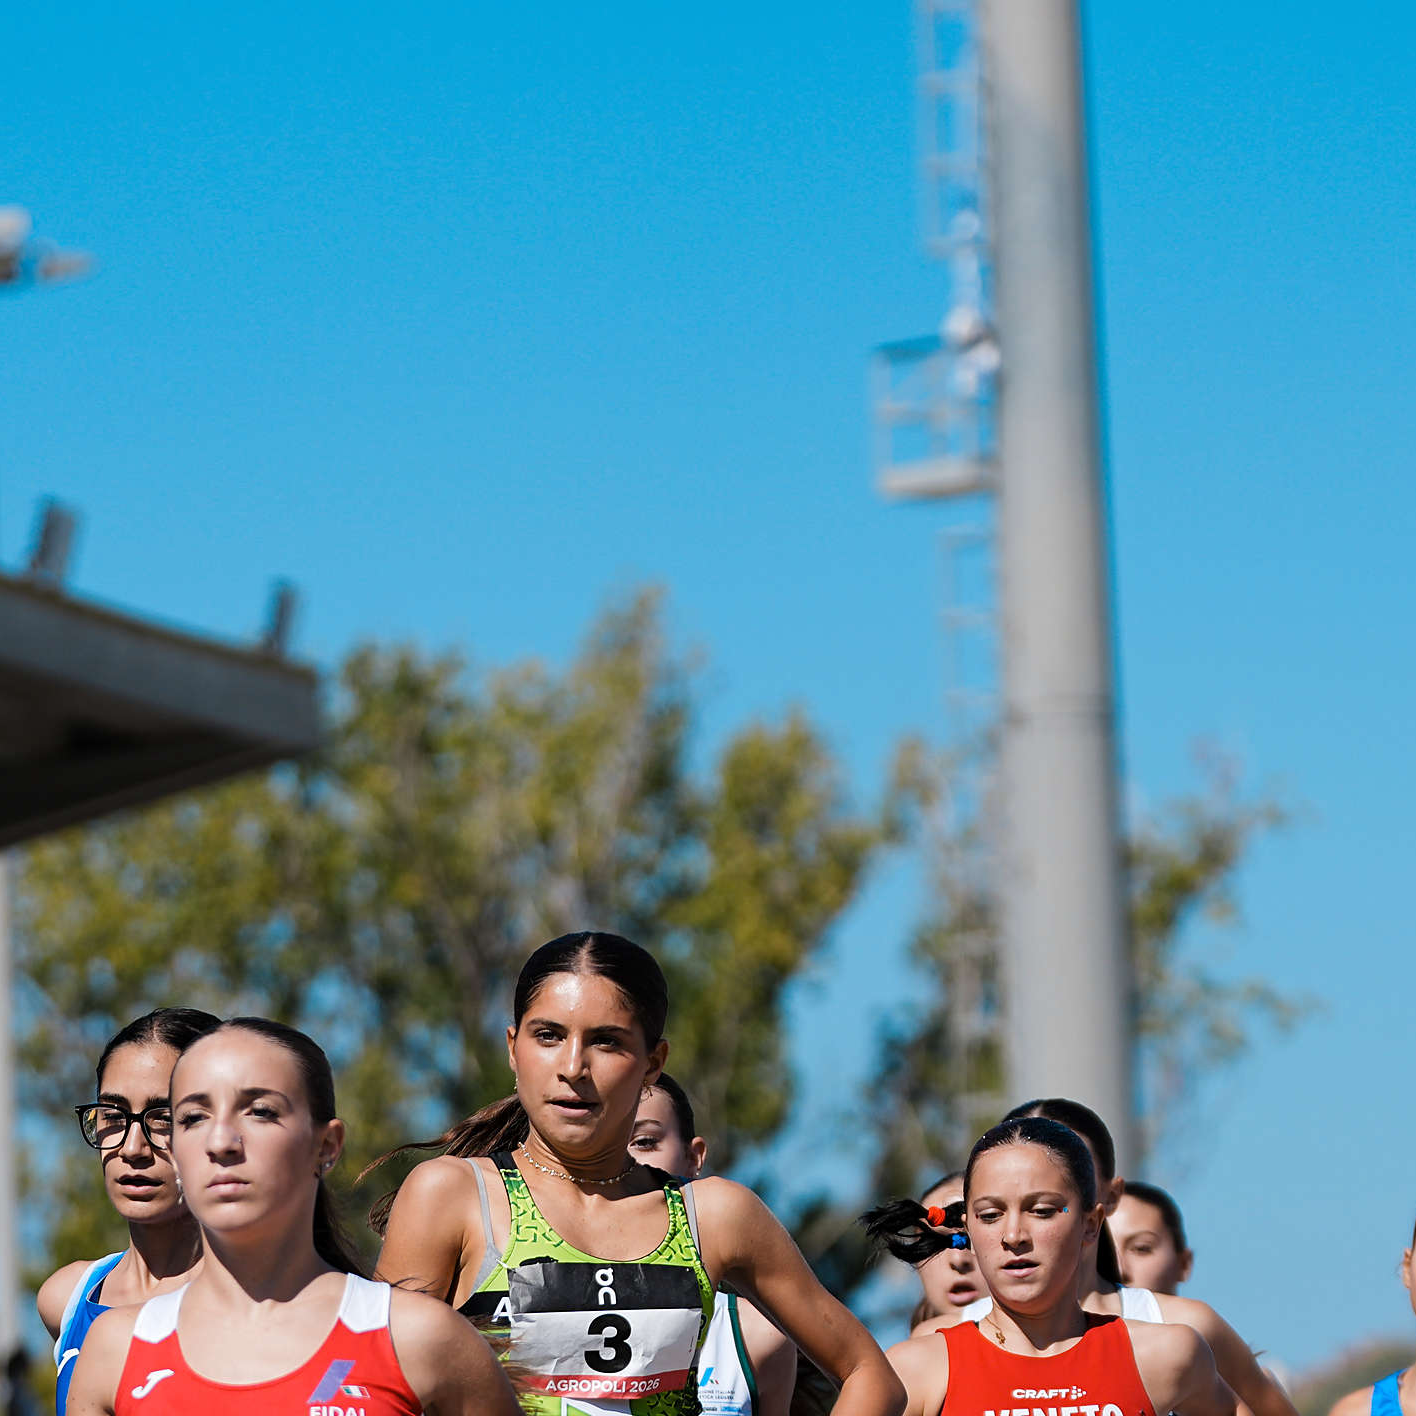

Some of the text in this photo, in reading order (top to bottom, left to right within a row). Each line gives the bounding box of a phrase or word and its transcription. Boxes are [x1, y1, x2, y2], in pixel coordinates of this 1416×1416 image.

[584, 1313, 632, 1373] 3
[545, 1378, 660, 1393] AGROPOLI 2026
[1012, 1388, 1070, 1399] CRAFT
